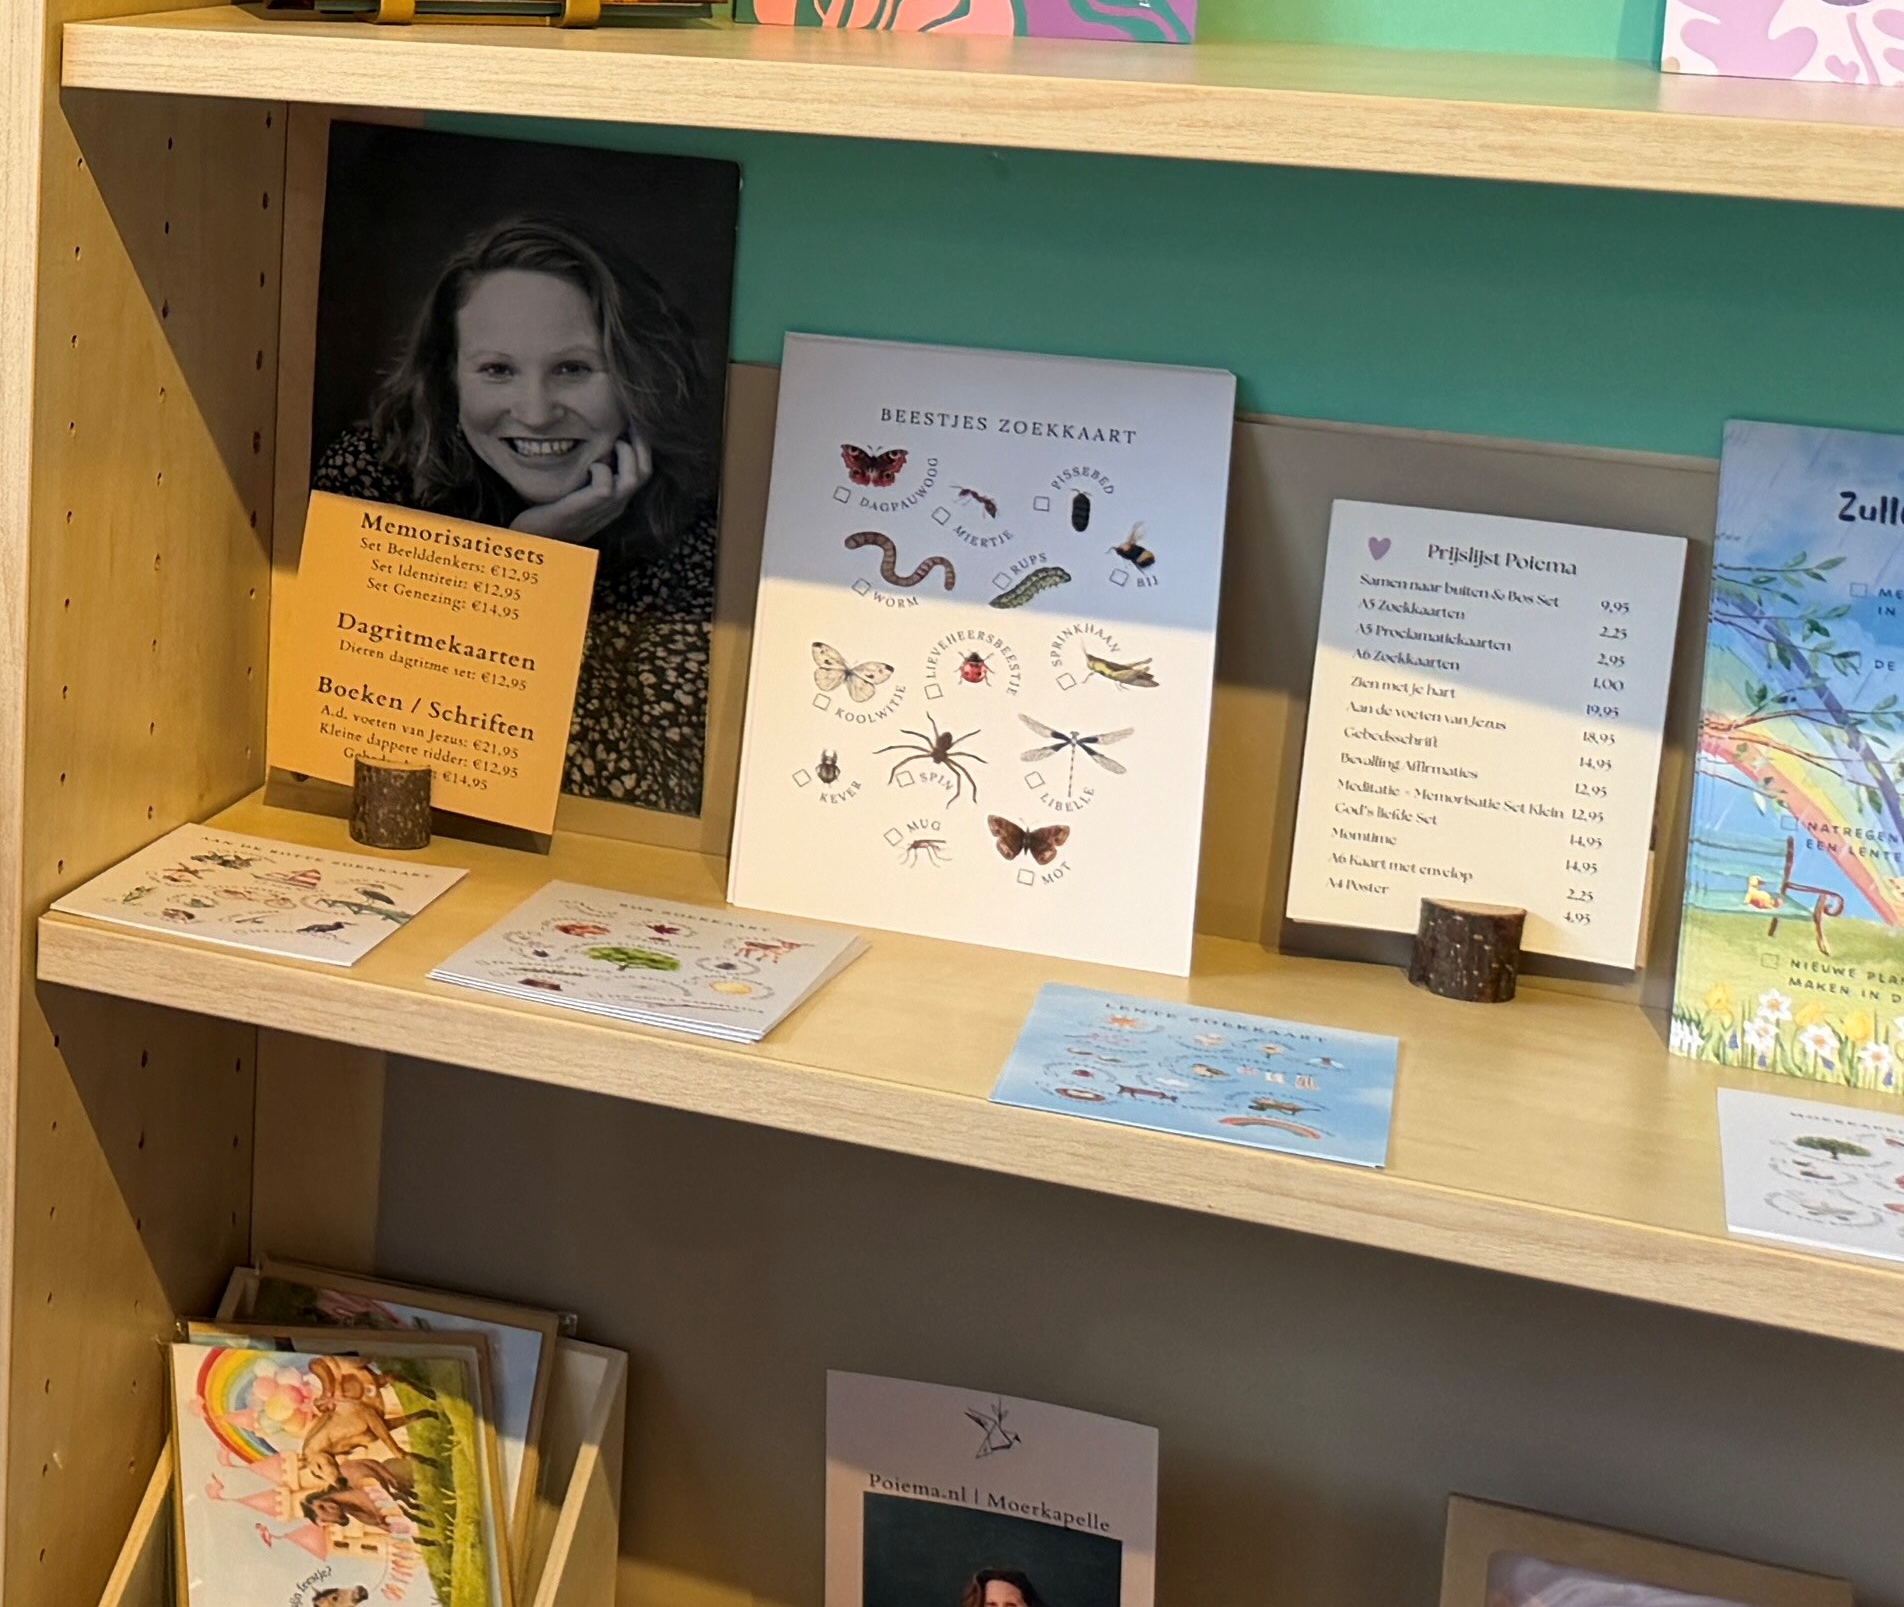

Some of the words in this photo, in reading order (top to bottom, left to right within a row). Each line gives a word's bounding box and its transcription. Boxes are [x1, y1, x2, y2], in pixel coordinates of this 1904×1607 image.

[881, 408, 988, 431] BEESTJES
[999, 418, 1137, 445] ZOEKKAART
[1051, 466, 1115, 495] PISSEBED
[1839, 491, 1904, 525] Zull
[360, 512, 545, 566] Memorisatiesets
[1010, 552, 1048, 575] RUPS
[1428, 543, 1500, 569] Prijslijst
[1505, 552, 1577, 576] Poiema
[367, 578, 388, 592] Set
[394, 583, 466, 612] Genezing:
[337, 612, 536, 671] Dagritmekaarten
[1048, 623, 1120, 667] SPRINKHAAN
[318, 675, 403, 711] Boeken
[411, 698, 421, 713] /
[429, 701, 534, 741] Schriften
[835, 684, 906, 723] KOOLWITJE
[321, 704, 347, 719] A.d.
[353, 714, 397, 731] voeten
[402, 724, 425, 737] van
[427, 729, 468, 747] Jezus:
[906, 819, 941, 833] MUG
[1806, 839, 1837, 852] EEN
[1042, 860, 1072, 885] MOT
[1791, 958, 1856, 978] NIEUWE
[1789, 977, 1849, 995] MAKEN
[1862, 990, 1880, 1000] IN
[869, 1473, 966, 1503] Poiema.nl
[987, 1493, 1110, 1533] Moerkapelle
